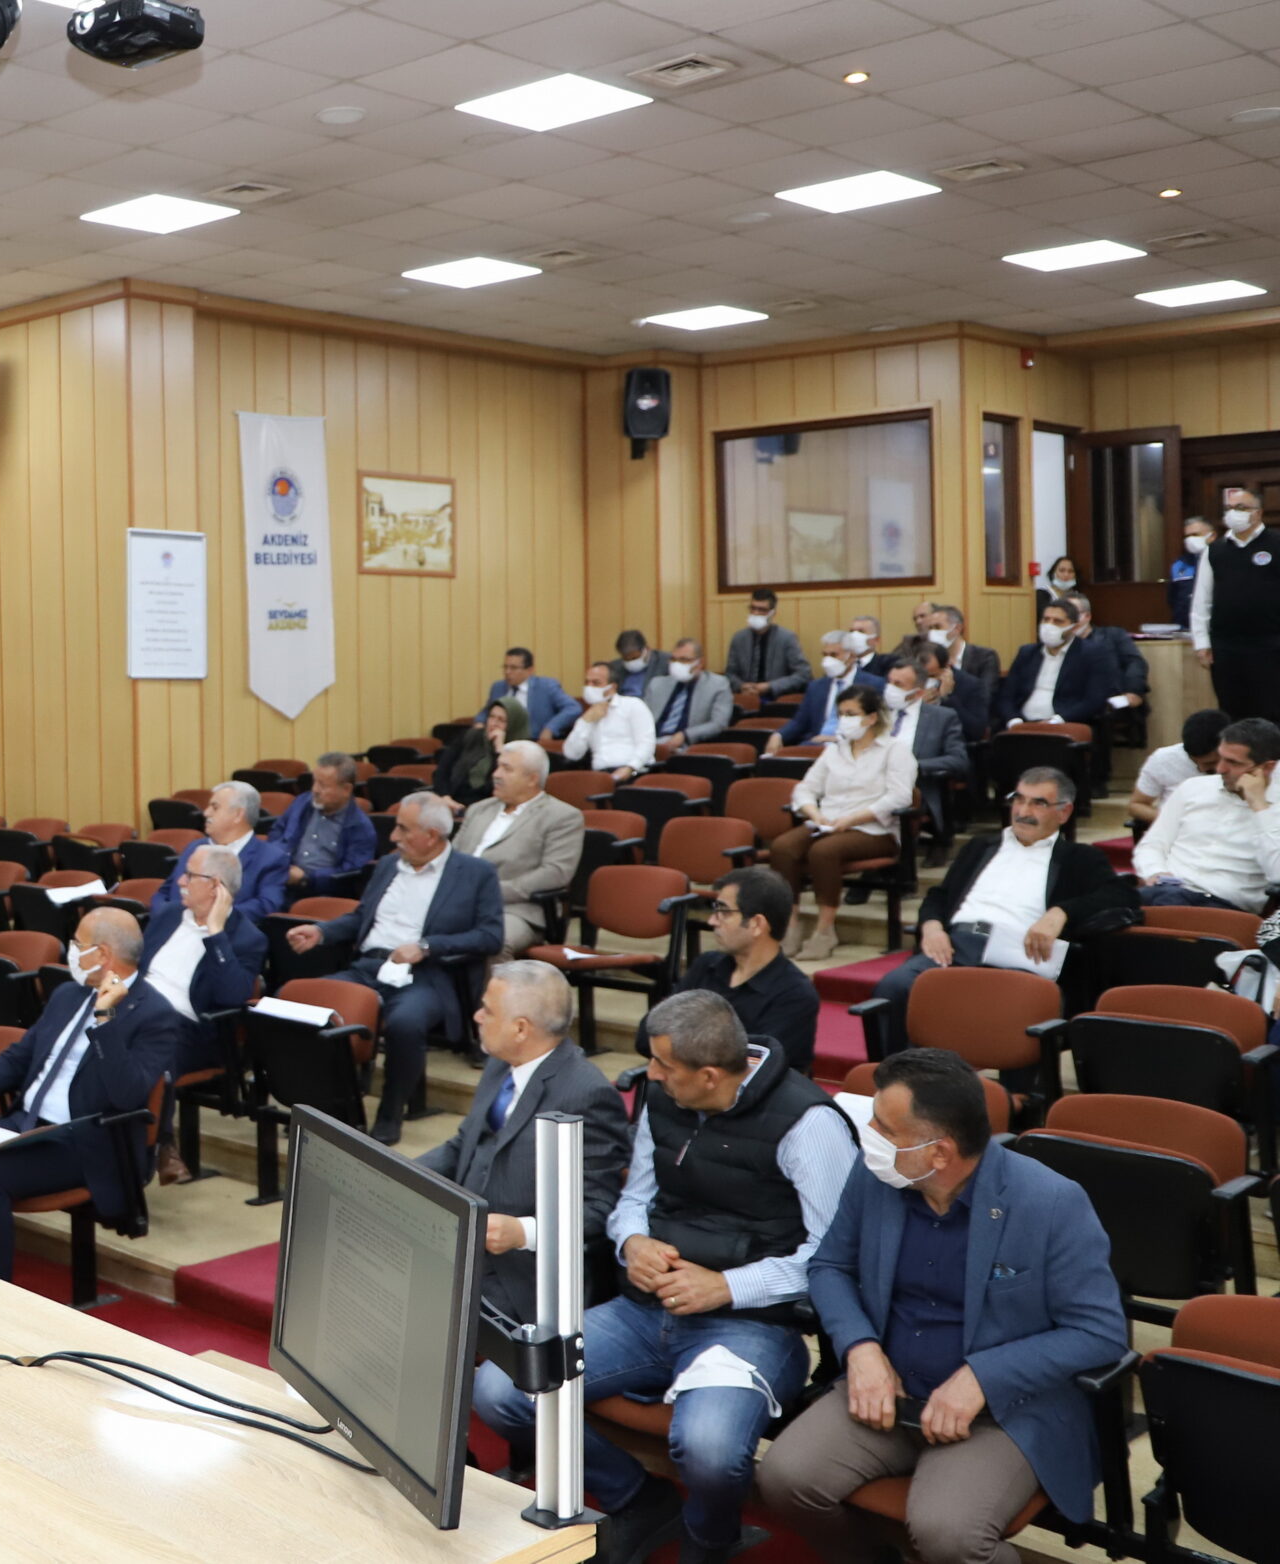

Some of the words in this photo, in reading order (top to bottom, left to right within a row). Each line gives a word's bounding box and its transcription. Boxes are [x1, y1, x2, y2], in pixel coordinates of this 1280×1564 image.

[262, 529, 308, 547] AKDENİZ
[254, 550, 318, 566] BELEDİYESİ
[336, 1417, 353, 1439] Lenovo
